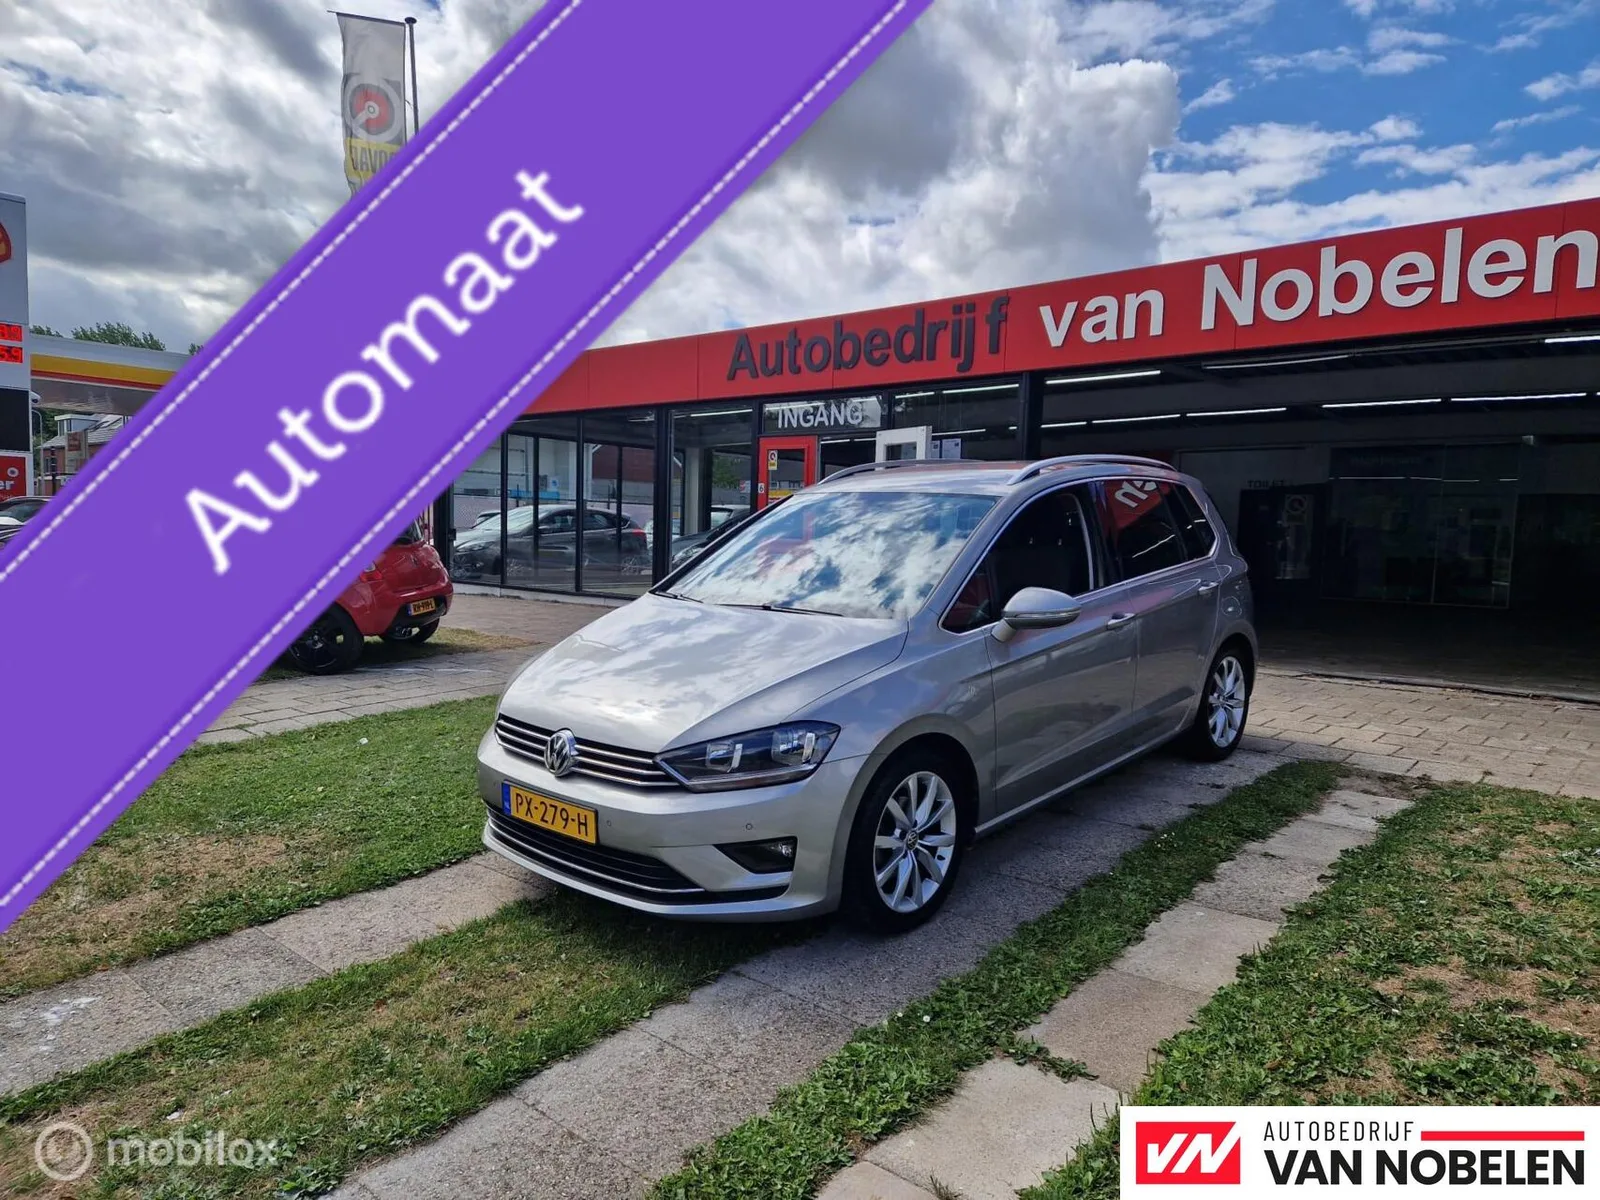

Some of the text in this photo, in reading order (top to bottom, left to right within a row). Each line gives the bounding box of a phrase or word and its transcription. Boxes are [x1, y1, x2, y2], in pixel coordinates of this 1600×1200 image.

[726, 227, 1599, 381] Autobedrijf van Nobelen
[777, 402, 864, 429] INGANG
[515, 792, 588, 837] PX-279-H
